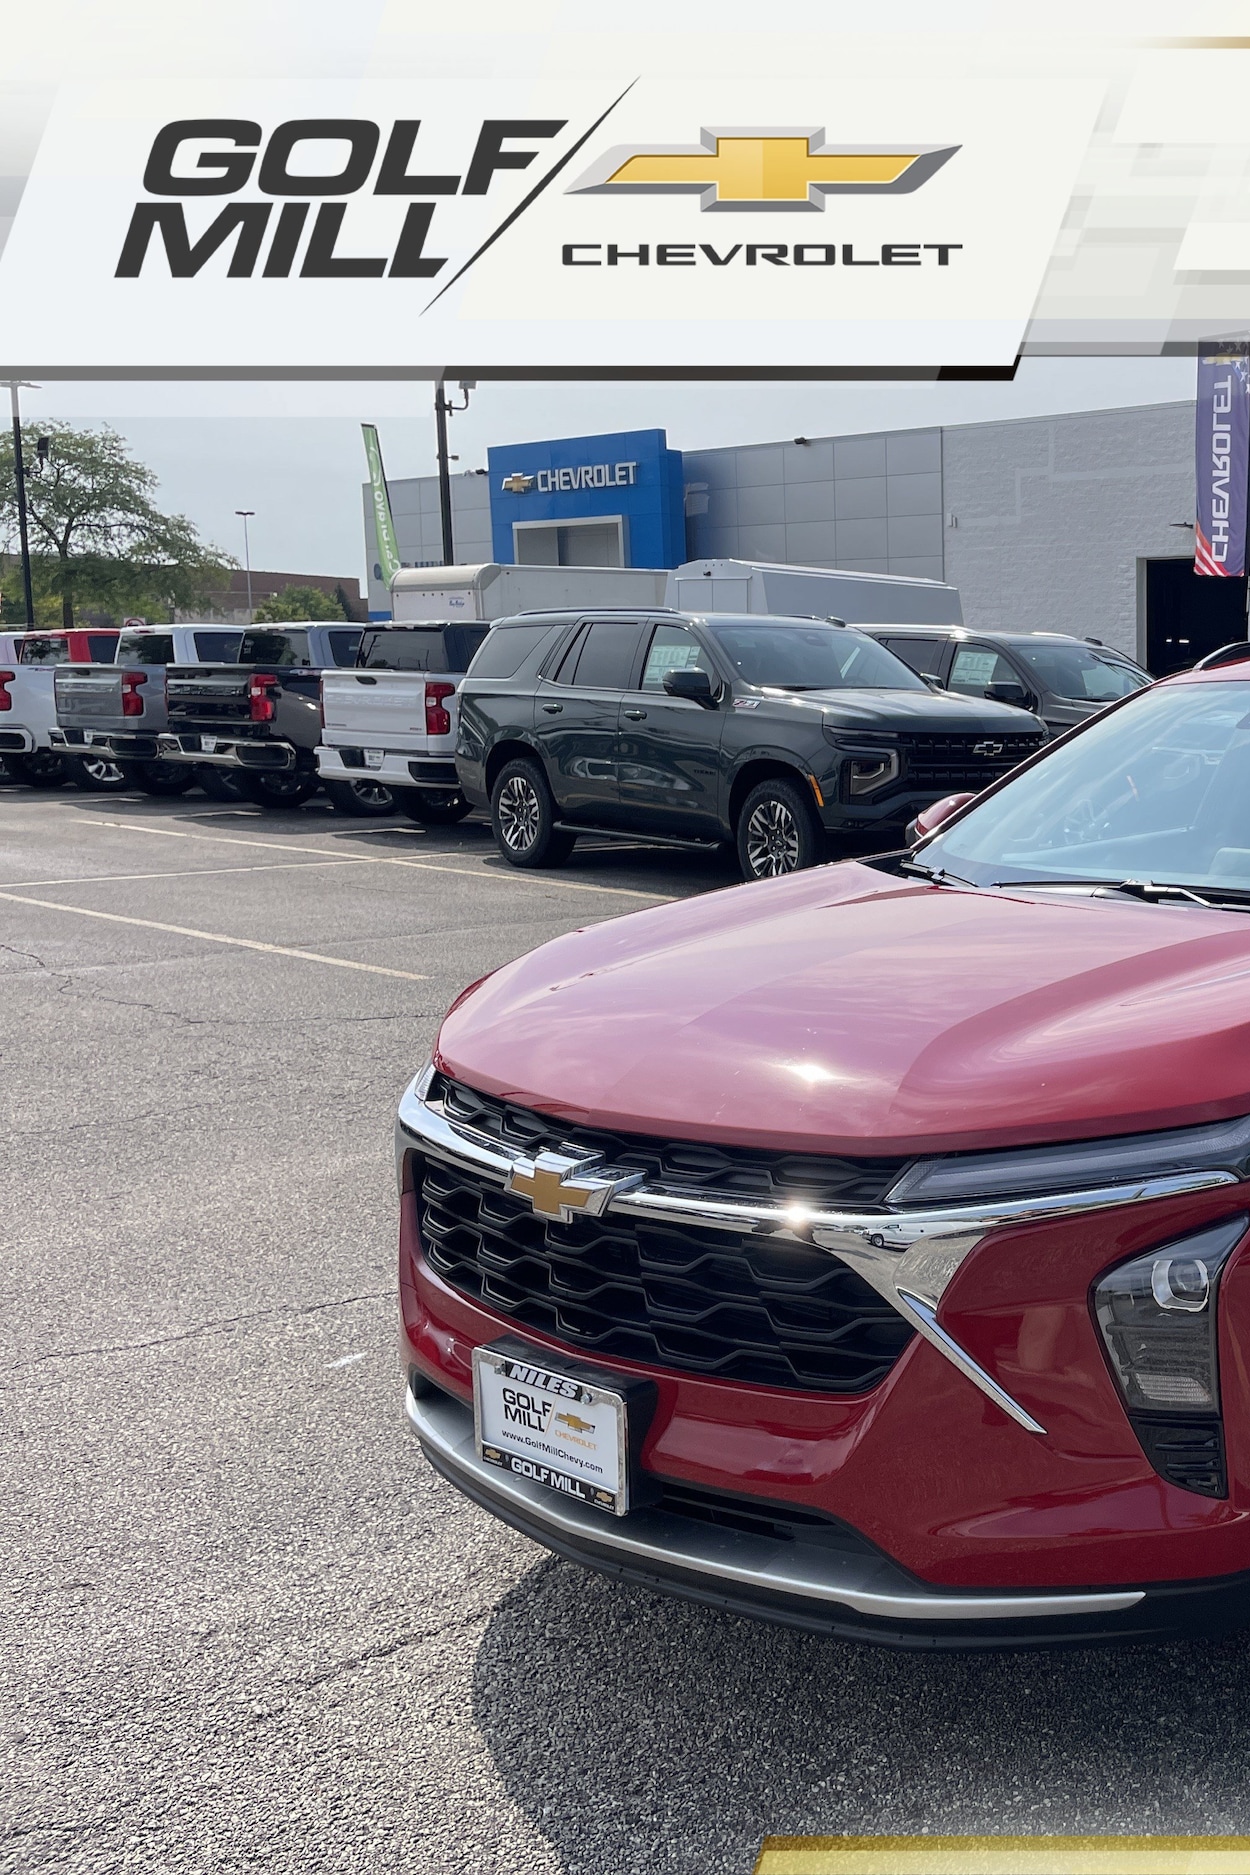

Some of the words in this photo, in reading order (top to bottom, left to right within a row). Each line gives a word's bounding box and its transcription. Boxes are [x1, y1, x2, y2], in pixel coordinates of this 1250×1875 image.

[537, 461, 637, 492] CHEVROLET
[510, 1363, 579, 1399] NILES
[502, 1387, 552, 1417] GOLF
[504, 1404, 545, 1433] MILL
[501, 1430, 603, 1474] www.GolfMillChevy.com
[555, 1430, 597, 1451] CHEVROLET
[511, 1457, 550, 1479] GOLF
[550, 1471, 586, 1499] MILL
